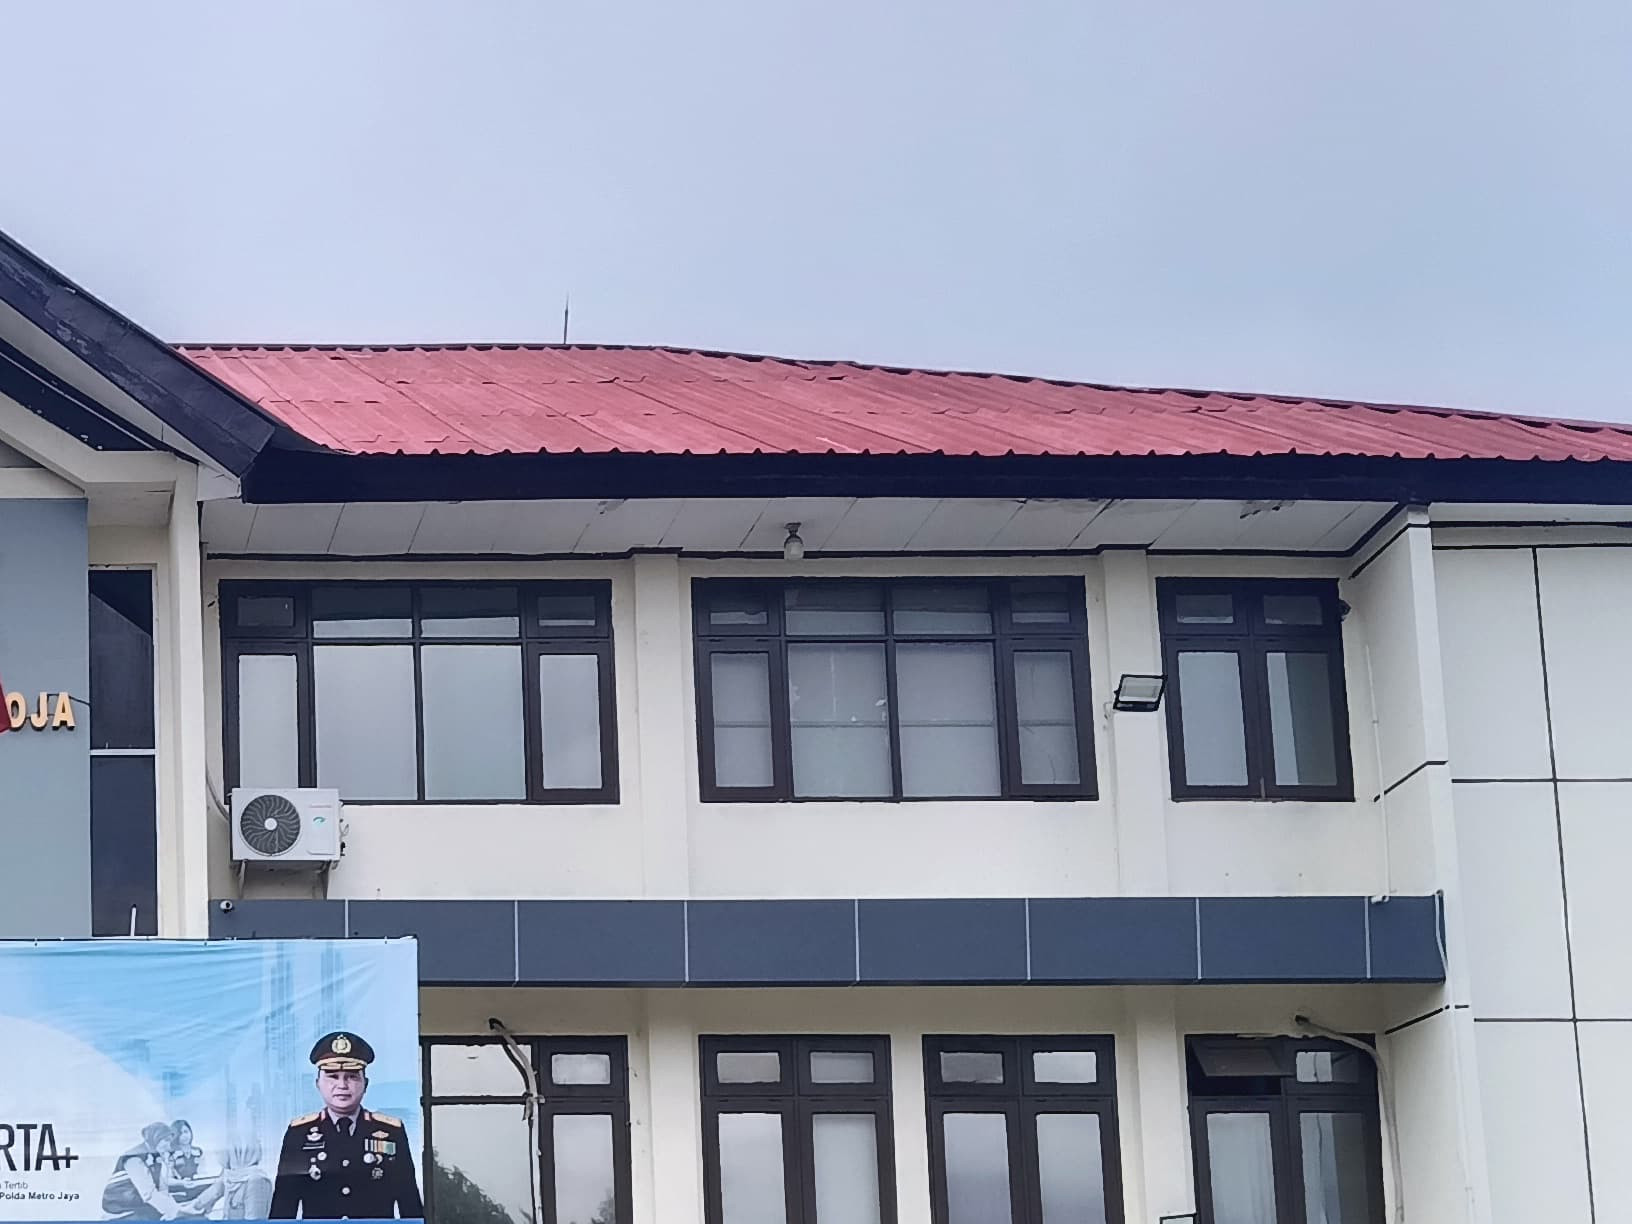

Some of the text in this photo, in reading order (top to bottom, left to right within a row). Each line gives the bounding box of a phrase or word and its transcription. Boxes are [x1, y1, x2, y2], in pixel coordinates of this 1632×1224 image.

[4, 1181, 29, 1190] Tertib
[28, 1192, 55, 1200] Metro
[58, 1192, 80, 1203] Jaya
